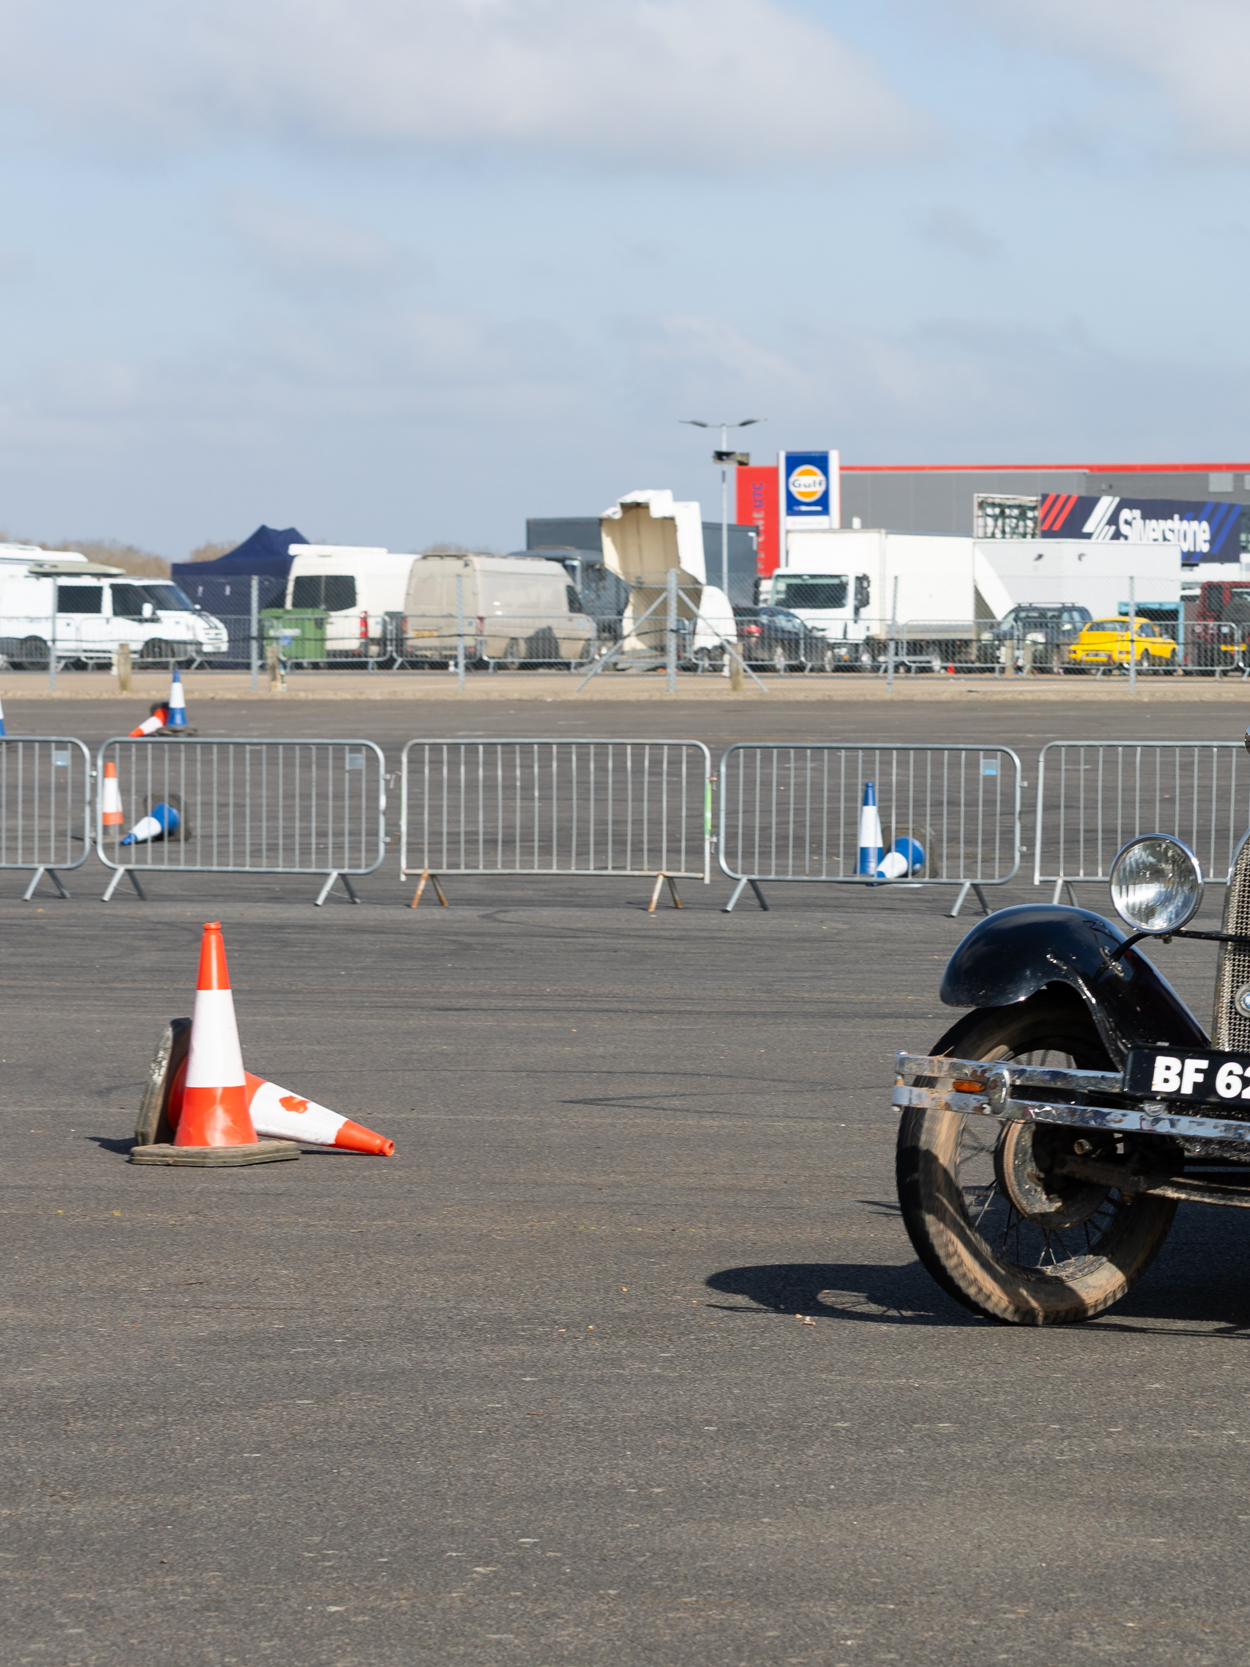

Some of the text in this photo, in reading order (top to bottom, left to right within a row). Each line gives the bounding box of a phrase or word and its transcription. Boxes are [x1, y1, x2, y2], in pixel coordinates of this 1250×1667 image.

[752, 482, 765, 508] UTC
[792, 479, 823, 488] Gulf
[1118, 508, 1211, 553] Silverstone
[1151, 1055, 1209, 1095] BF
